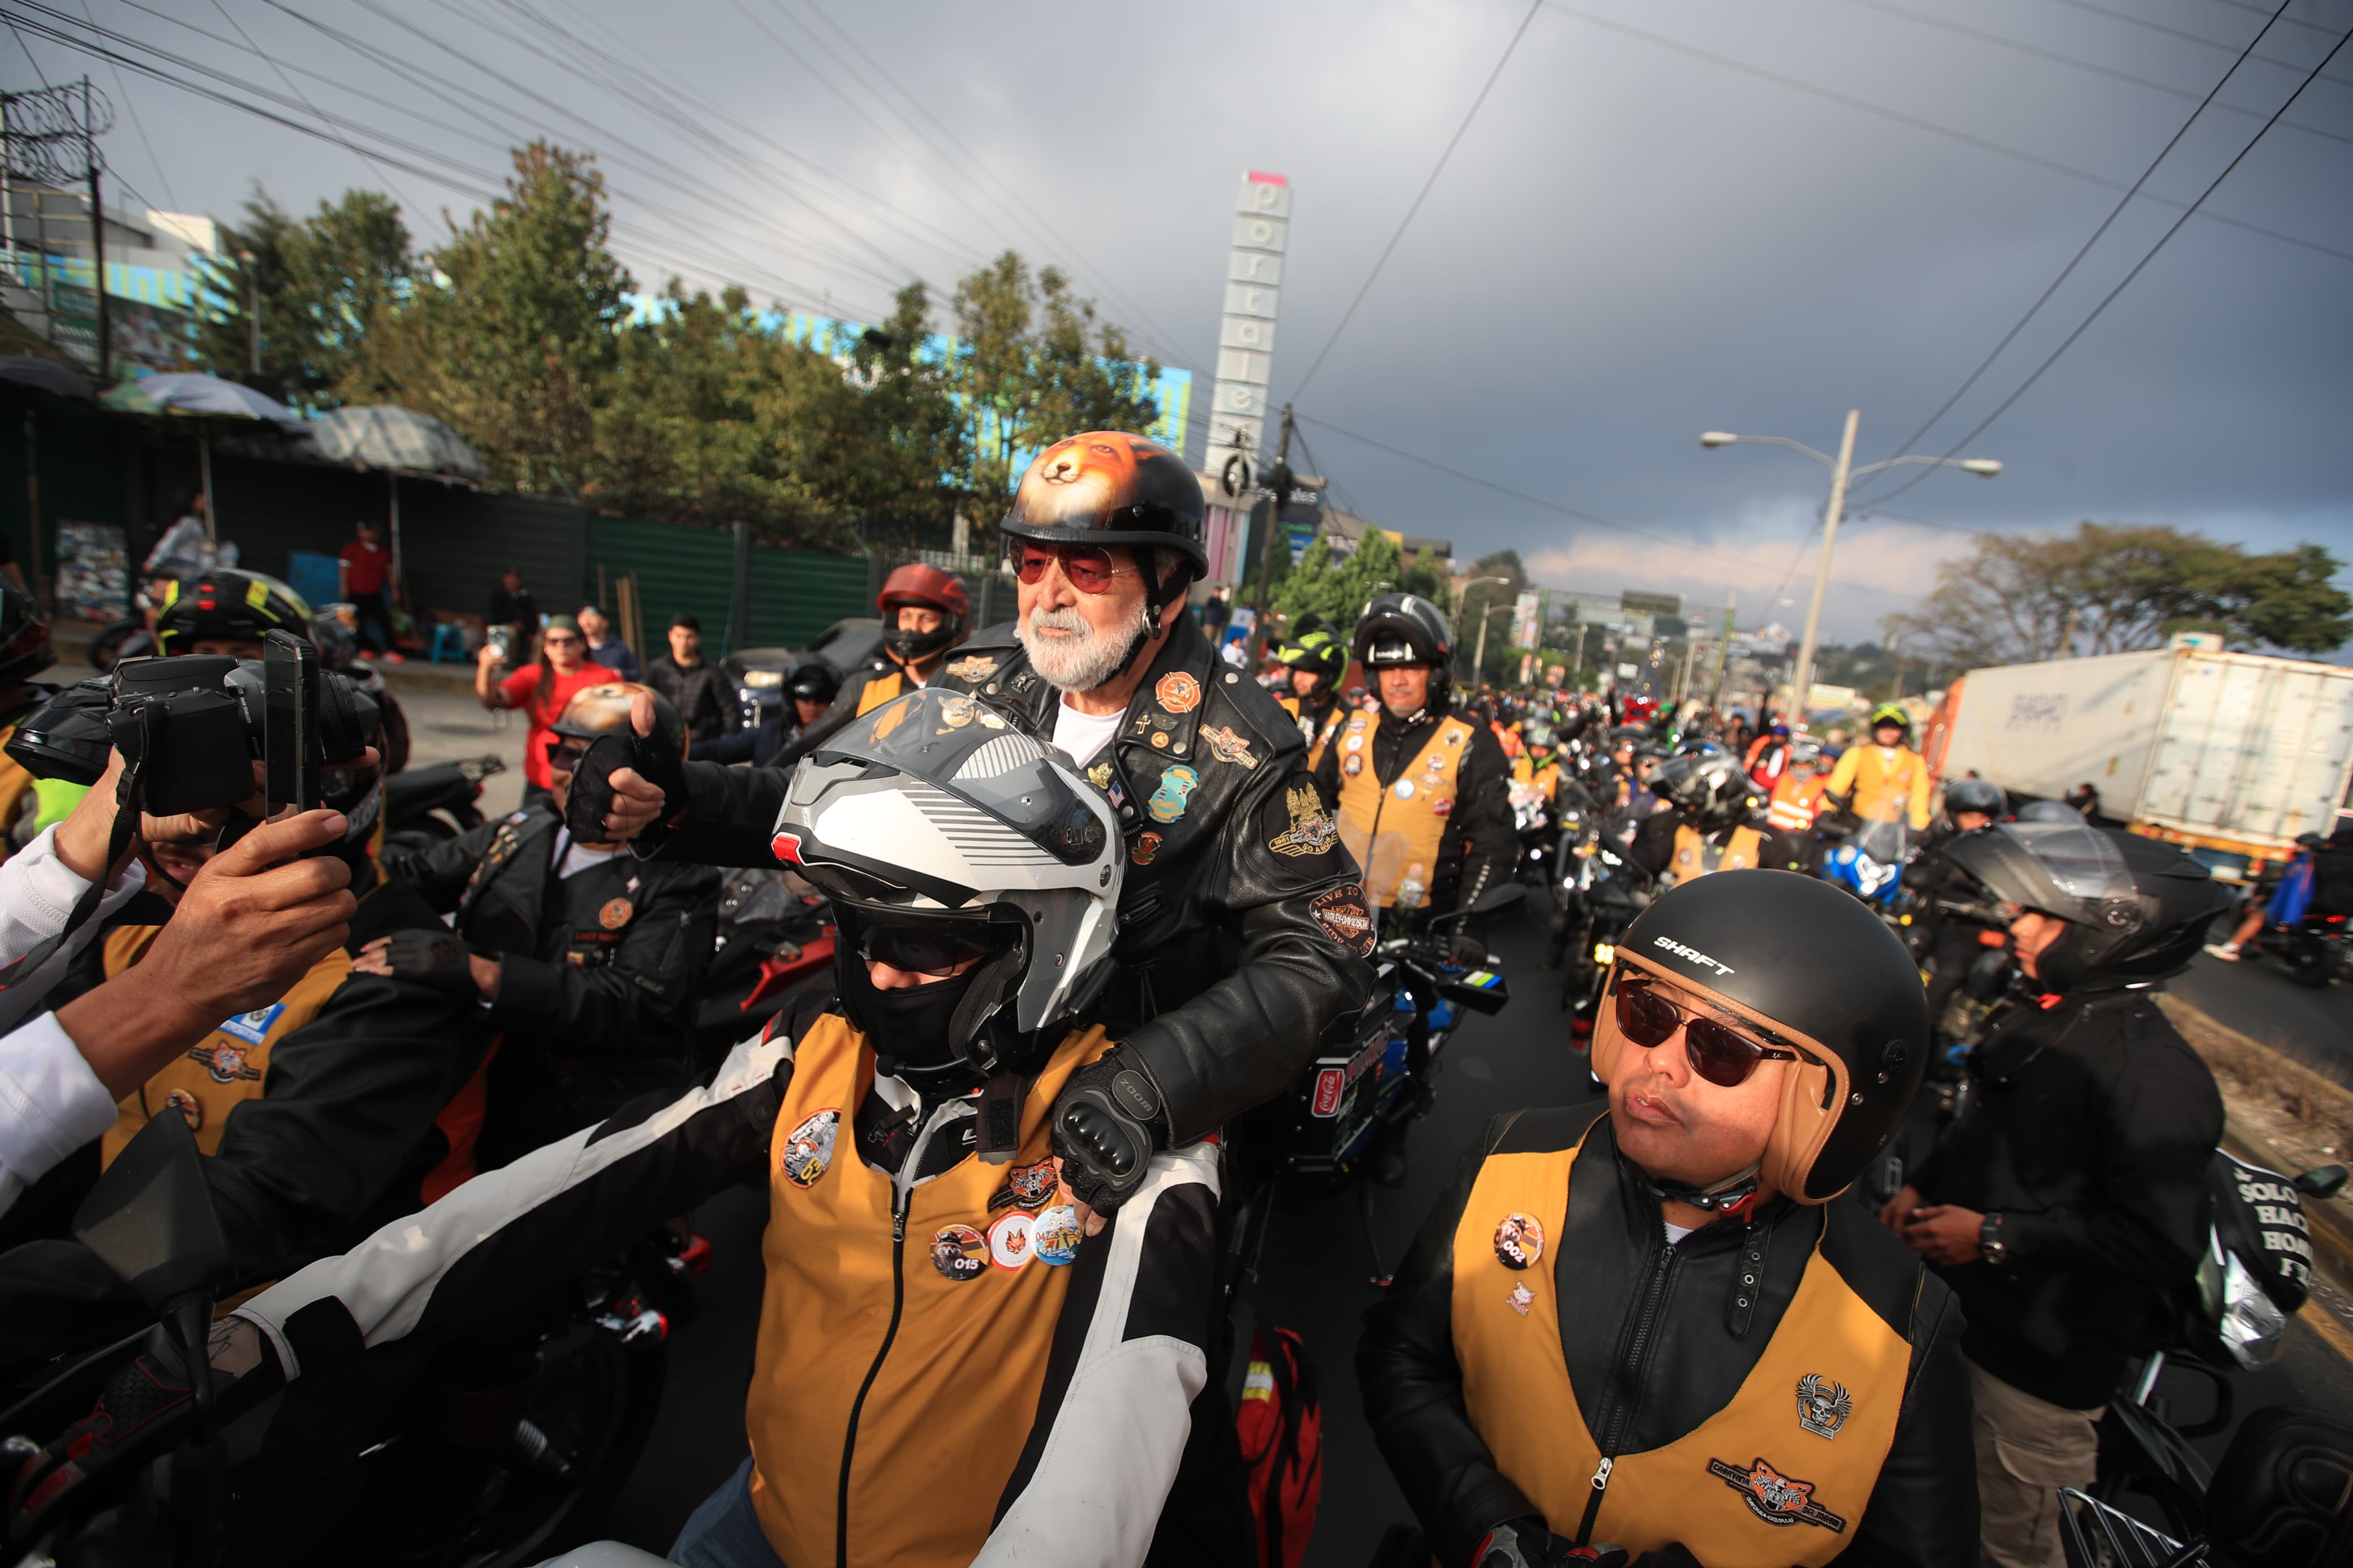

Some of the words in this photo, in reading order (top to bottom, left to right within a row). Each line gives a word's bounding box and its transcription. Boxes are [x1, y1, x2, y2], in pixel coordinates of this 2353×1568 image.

[1230, 182, 1278, 441] portale
[1205, 728, 1217, 739] 1961
[1240, 754, 1253, 765] 2016
[1274, 836, 1290, 846] 1961
[1302, 843, 1313, 853] 50
[1315, 889, 1343, 907] LIVE
[1346, 886, 1358, 896] TO
[1324, 910, 1368, 929] HARLEY-DAVIDSON
[1653, 936, 1735, 976] SHAFT
[2237, 1182, 2299, 1205] SOLO
[1503, 1239, 1527, 1263] 002
[954, 1258, 979, 1270] 015
[1713, 1462, 1750, 1487] CARAVANA
[1803, 1506, 1815, 1517] DEL
